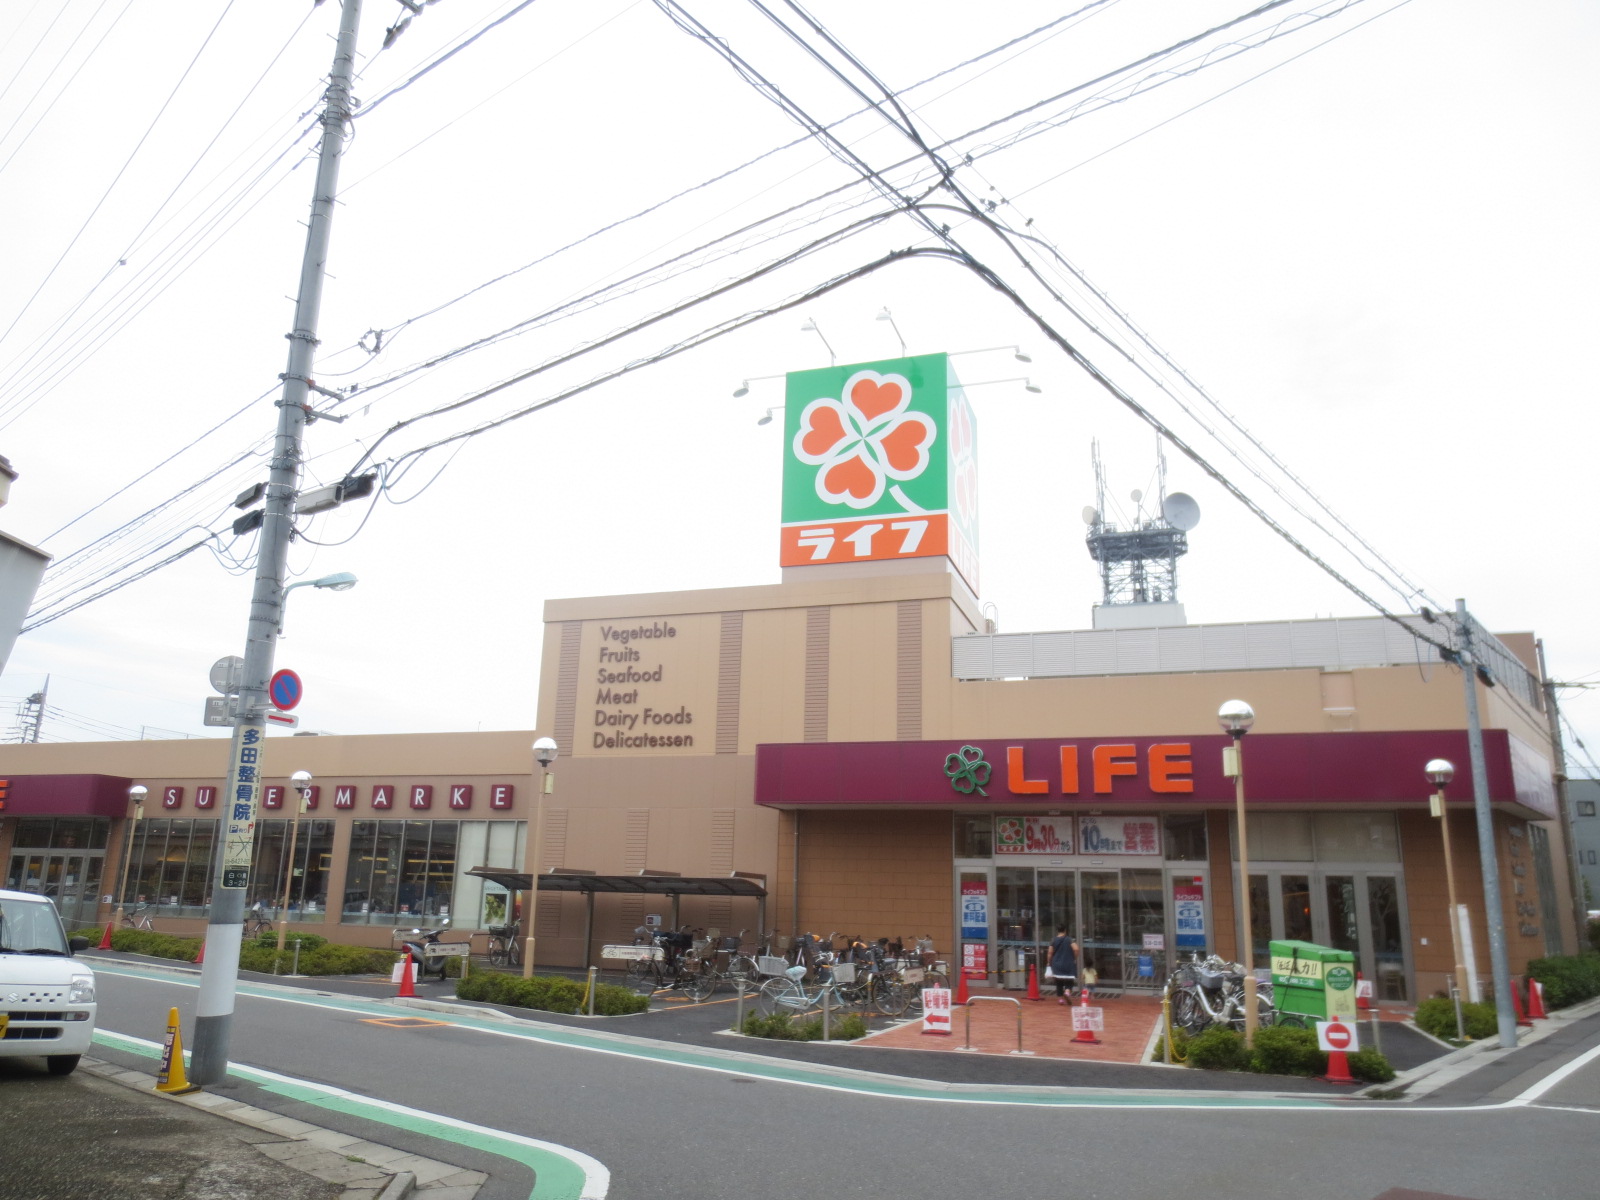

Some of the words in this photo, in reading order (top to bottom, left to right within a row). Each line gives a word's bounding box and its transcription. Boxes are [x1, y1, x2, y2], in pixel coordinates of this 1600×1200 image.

[797, 519, 929, 560] ライフ
[600, 621, 677, 645] Vegetable
[599, 646, 641, 663] Fruits
[597, 663, 663, 684] Seafood
[595, 687, 639, 705] Meat
[594, 709, 639, 731] Dairy
[643, 705, 693, 725] Foods
[592, 729, 694, 749] Delicatessen
[233, 728, 259, 820] 多田整骨院
[1007, 742, 1194, 794] LIFE
[166, 787, 506, 807] SUERMARKE
